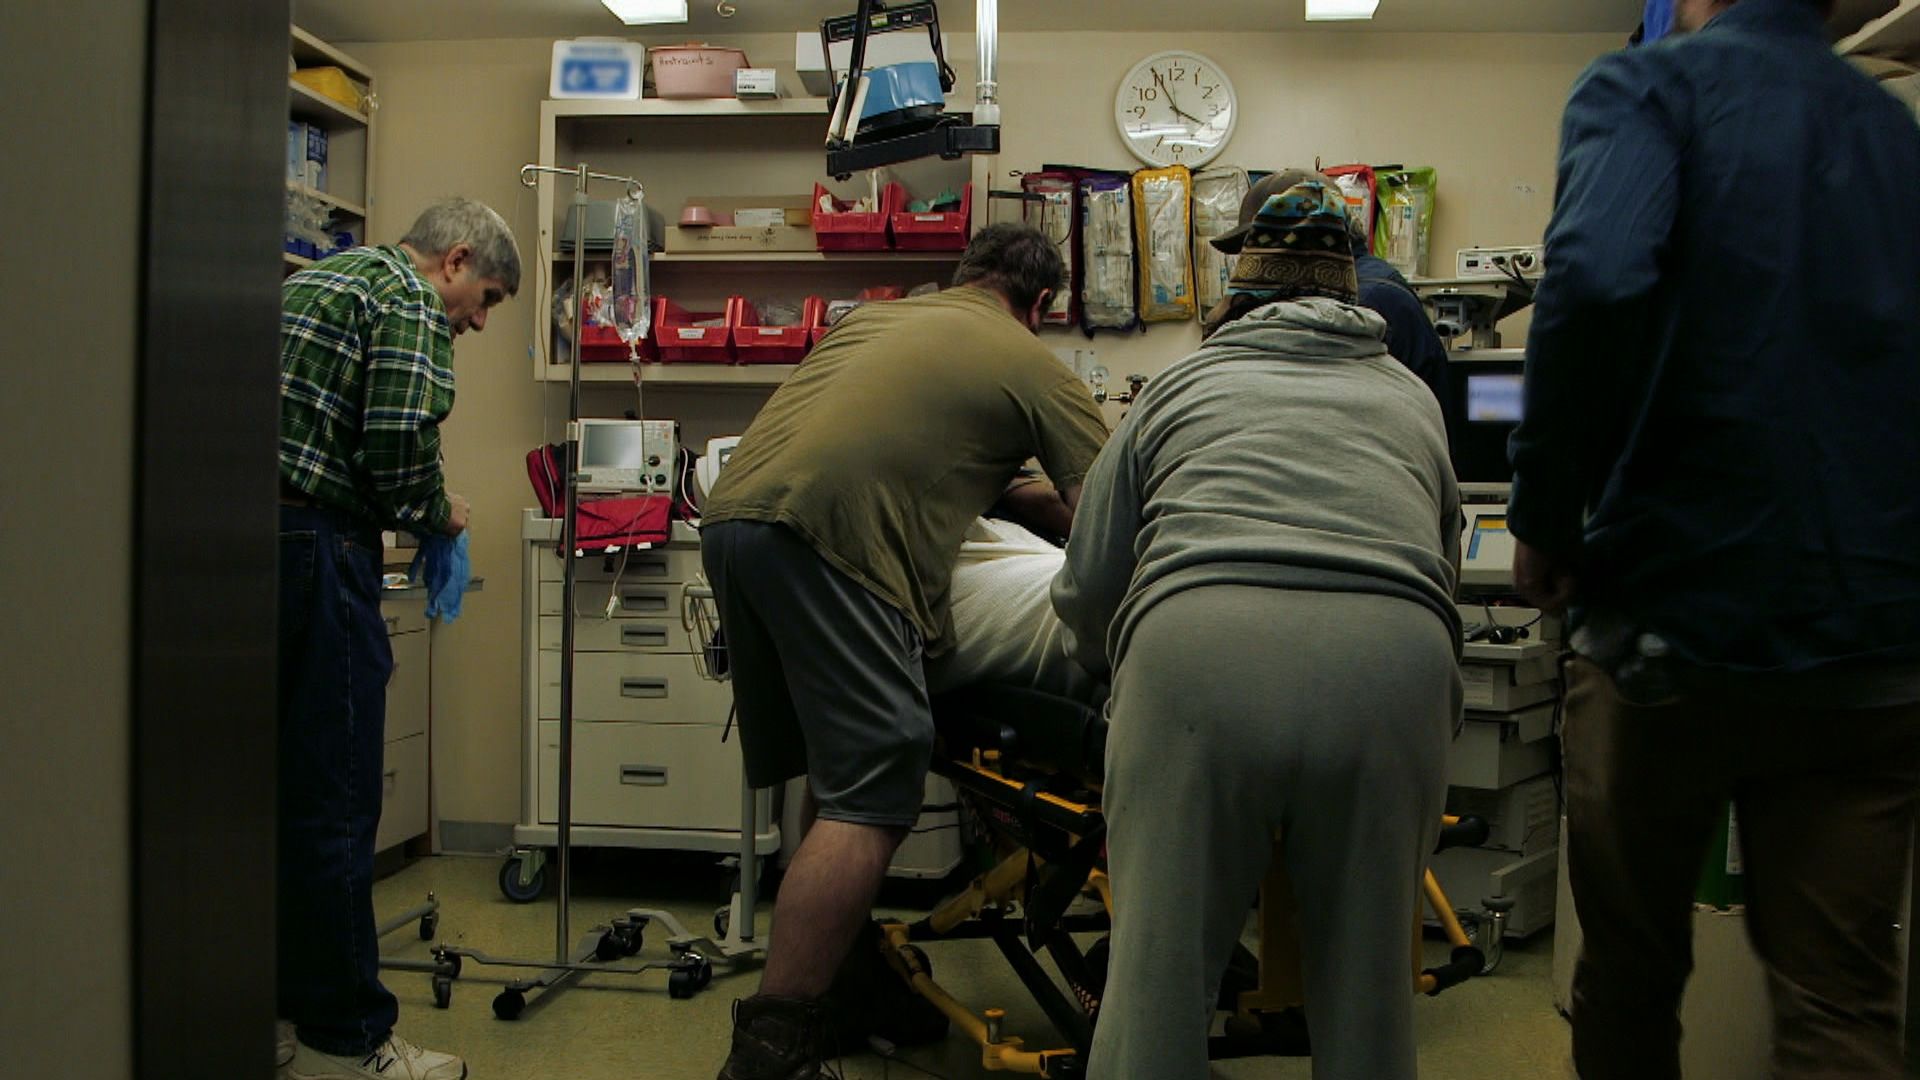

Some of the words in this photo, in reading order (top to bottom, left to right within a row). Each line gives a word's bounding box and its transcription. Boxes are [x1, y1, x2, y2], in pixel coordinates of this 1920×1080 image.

[659, 52, 713, 66] Restraints
[1168, 68, 1185, 81] 12
[1194, 73, 1199, 86] 1
[1138, 88, 1157, 101] 10
[1201, 86, 1213, 99] 2
[1134, 106, 1146, 119] 9
[1207, 103, 1219, 117] 3
